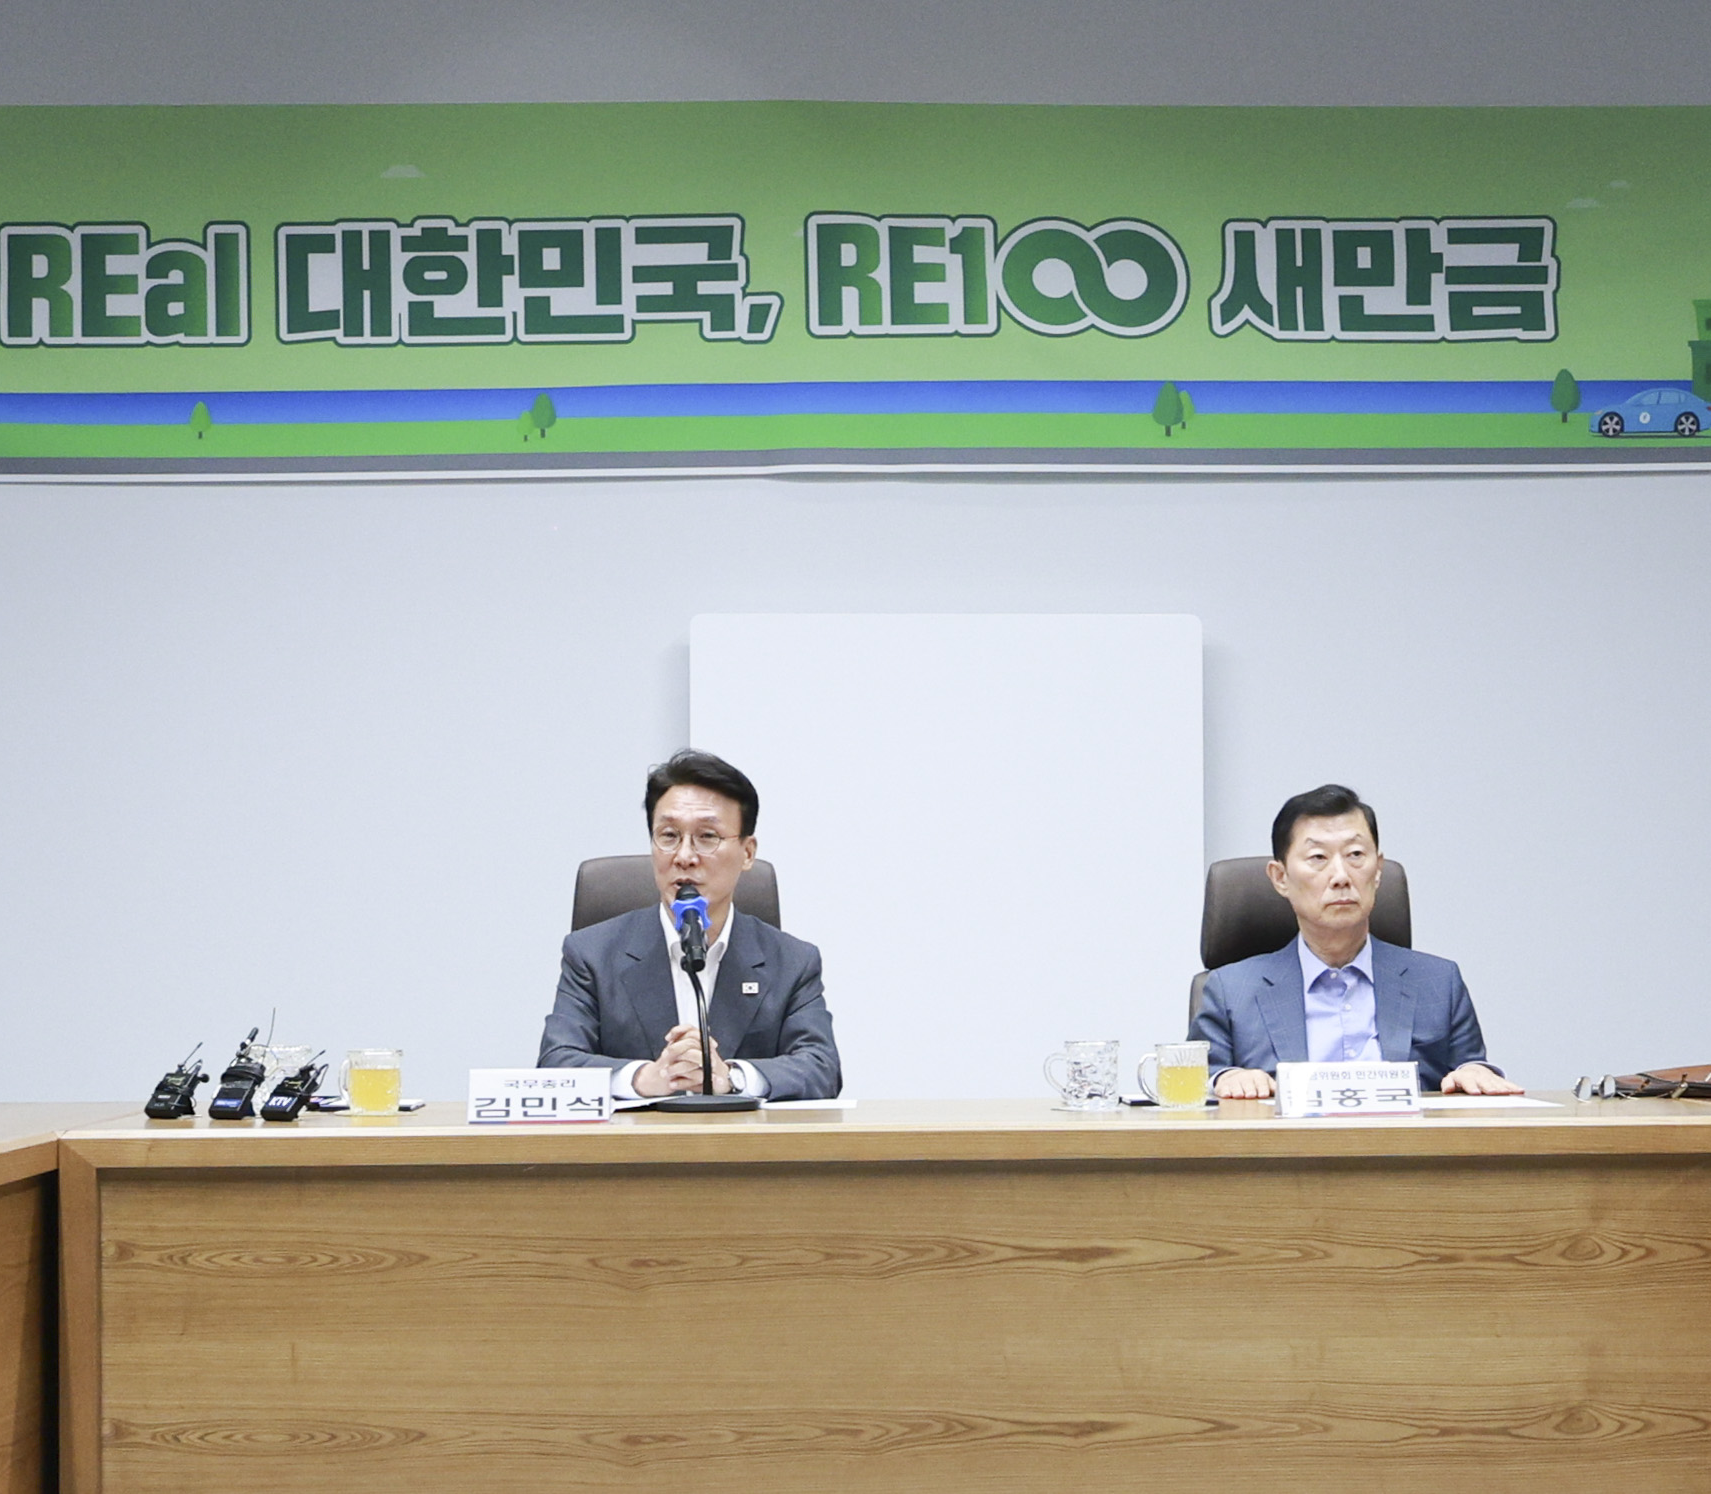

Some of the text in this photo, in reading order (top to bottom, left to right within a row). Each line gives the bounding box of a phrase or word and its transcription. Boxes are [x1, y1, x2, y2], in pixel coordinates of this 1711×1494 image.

[275, 214, 784, 348] 대한민국,
[1208, 216, 1560, 343] 새만금
[1356, 1069, 1410, 1080] 민간위원장
[504, 1079, 576, 1089] 국무총리
[268, 1096, 293, 1107] KTV
[475, 1096, 604, 1118] 김민석
